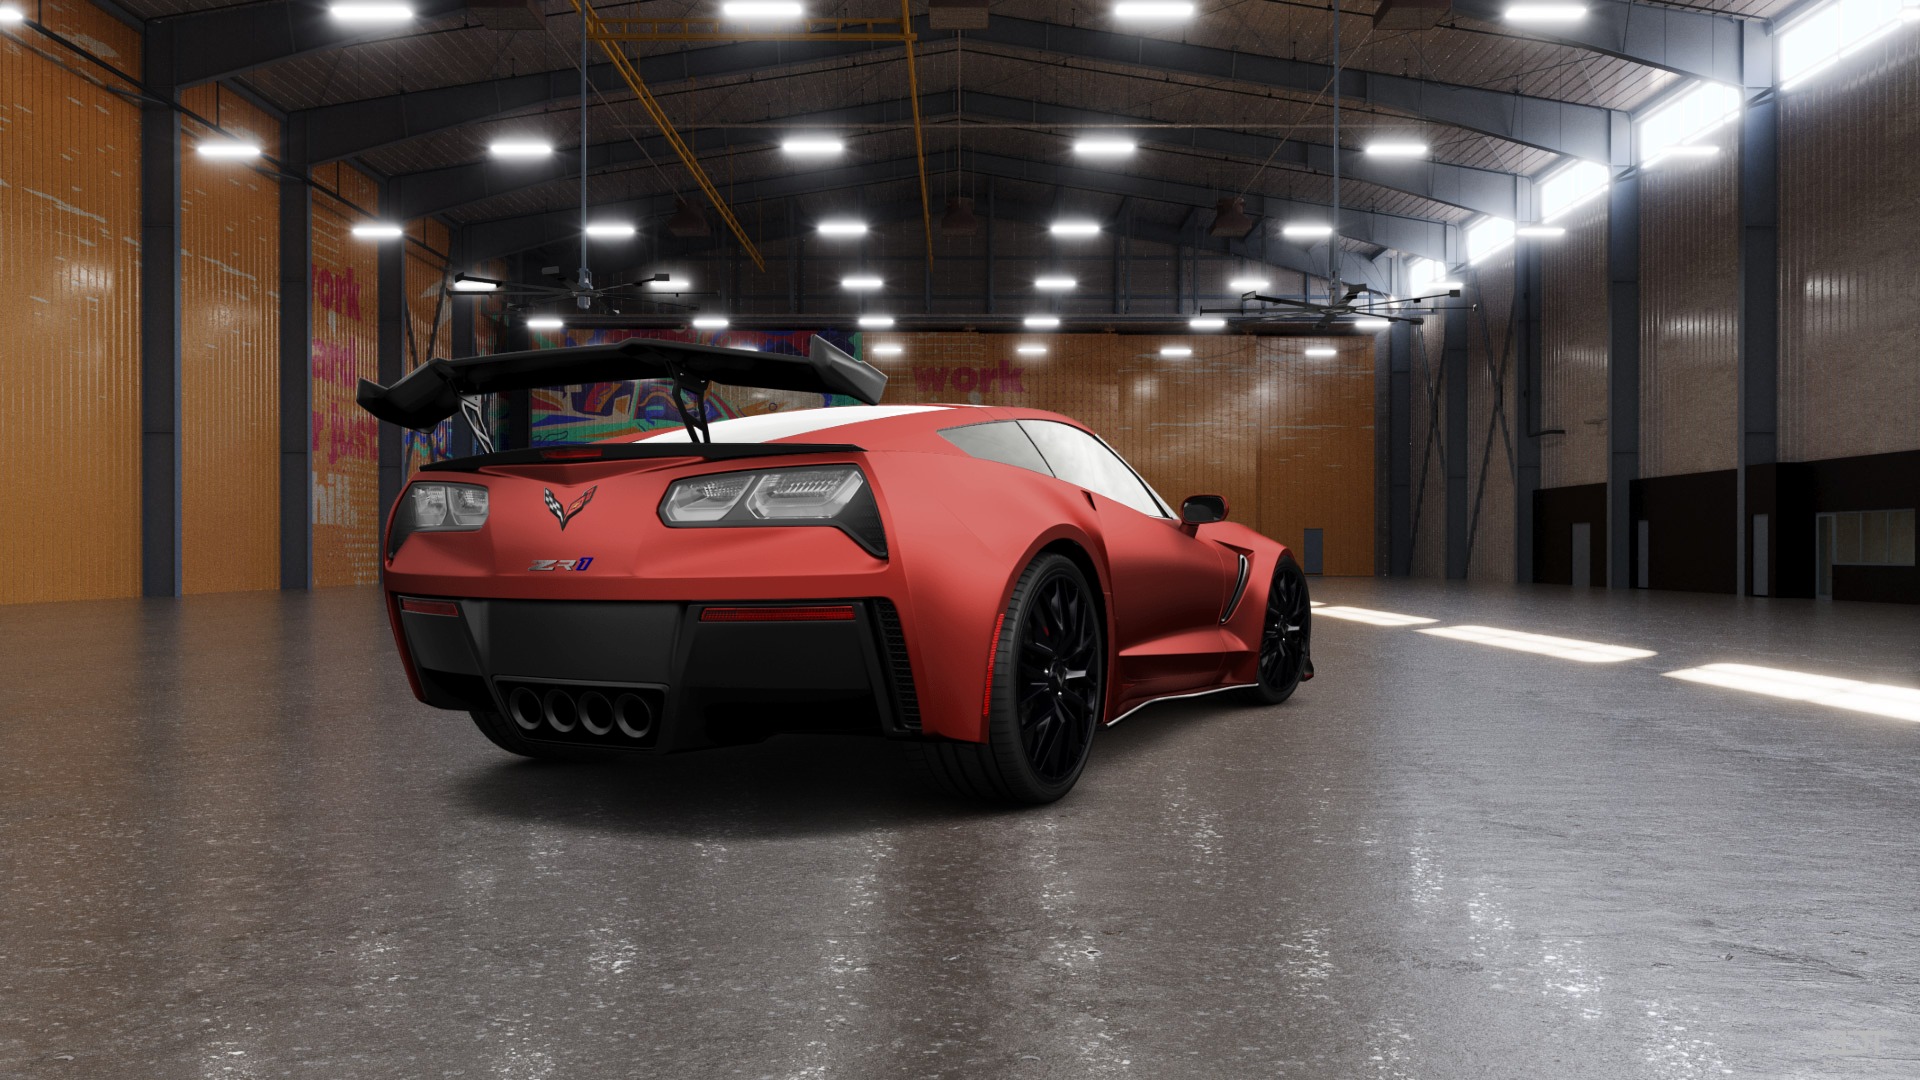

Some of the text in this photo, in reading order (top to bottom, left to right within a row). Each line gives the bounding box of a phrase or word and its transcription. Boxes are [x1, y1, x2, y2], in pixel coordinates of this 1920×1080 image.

[312, 337, 356, 390] ard
[912, 360, 1025, 393] work
[527, 557, 594, 571] ZR1
